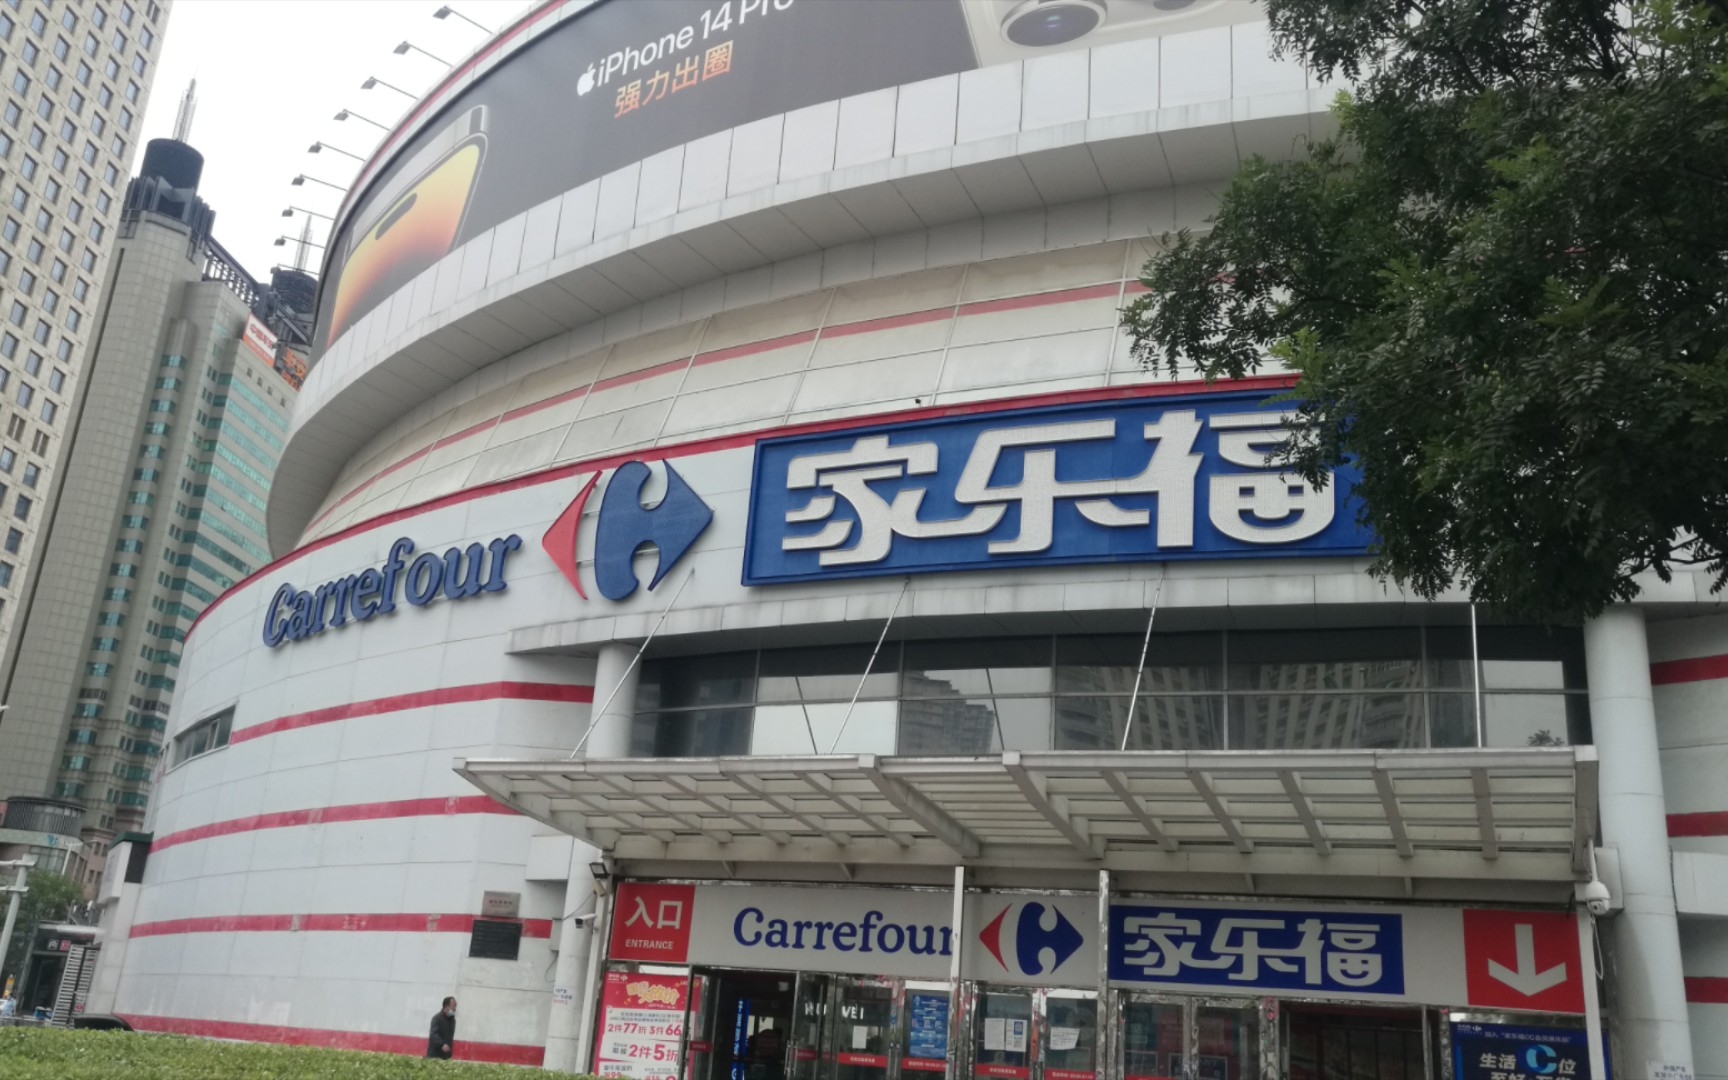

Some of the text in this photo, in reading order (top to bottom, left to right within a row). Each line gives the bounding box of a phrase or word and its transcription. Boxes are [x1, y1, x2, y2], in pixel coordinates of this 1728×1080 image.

[597, 25, 694, 87] iPhone
[700, 1, 733, 40] 14
[614, 40, 734, 119] 强力出圈
[781, 410, 1336, 566] 家乐福
[262, 534, 523, 648] Carrefour
[624, 896, 683, 930] 入口
[625, 939, 674, 950] ENTRANCE
[733, 907, 953, 957] Carrefour
[1123, 912, 1383, 987] 家乐福
